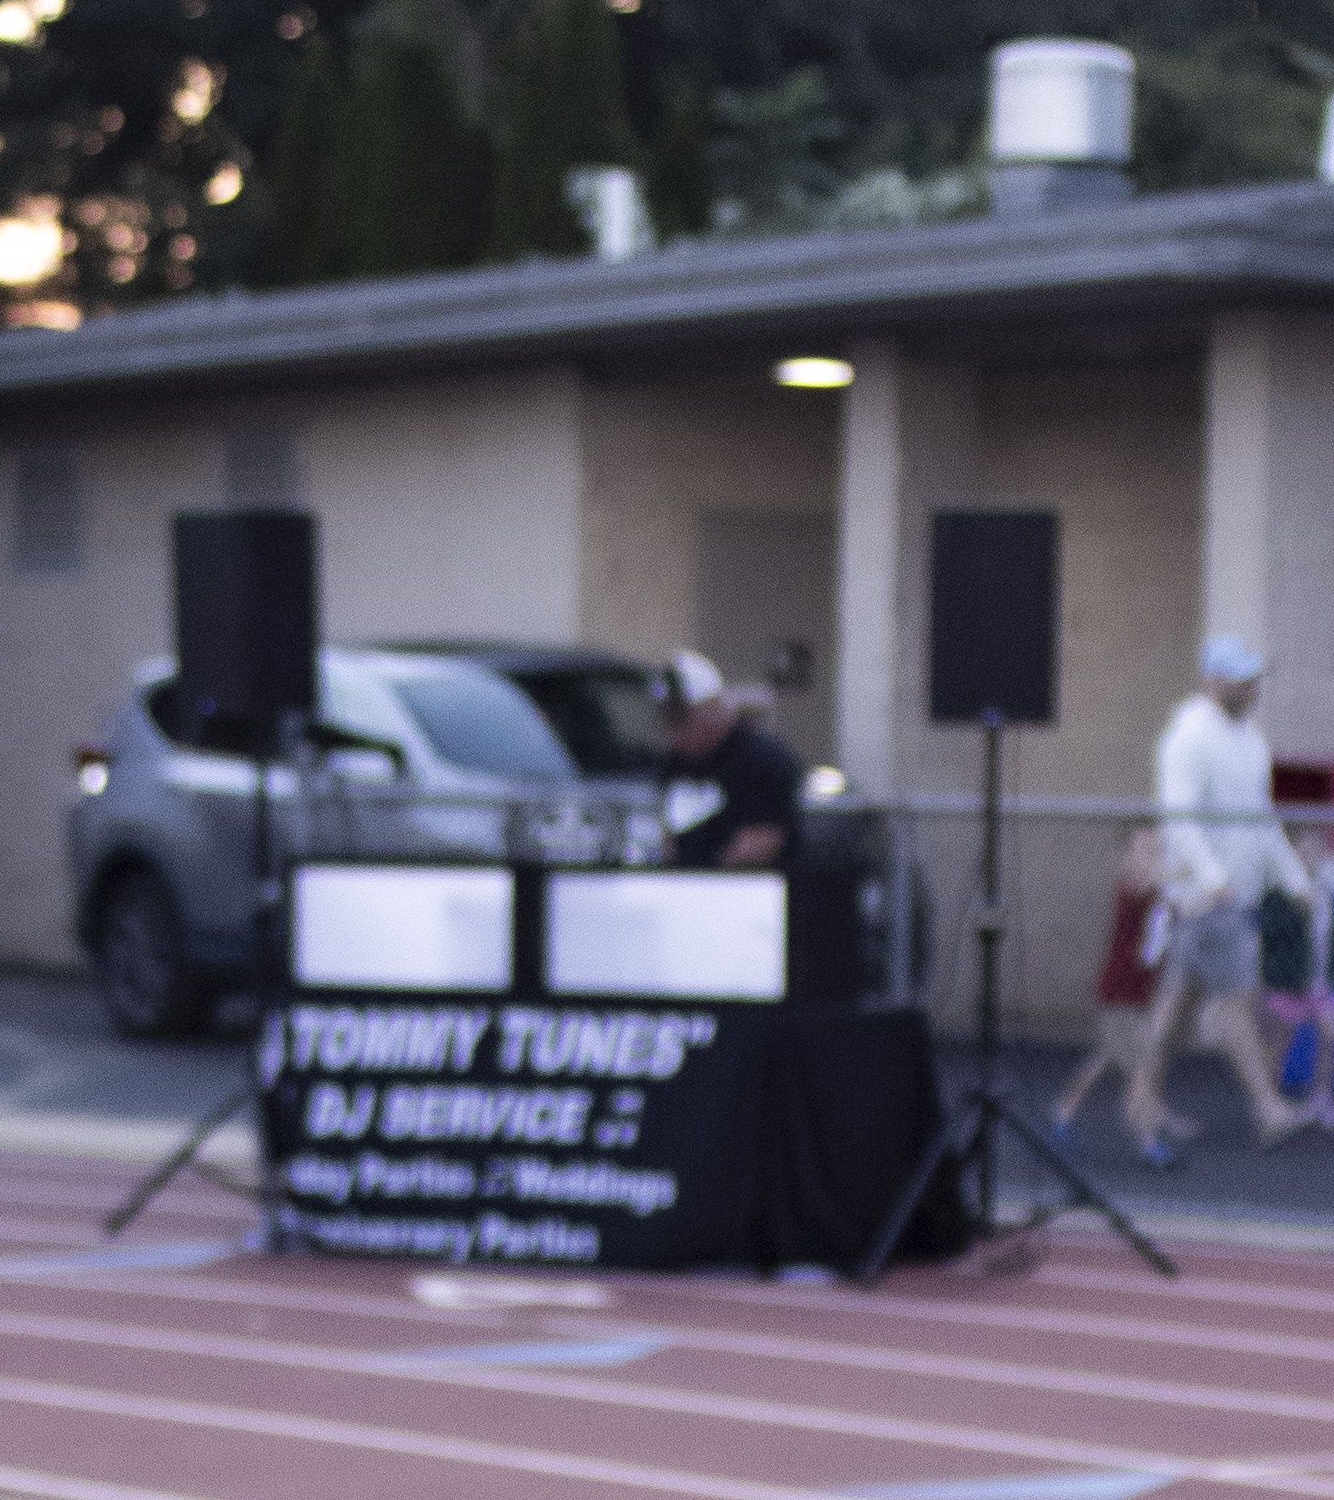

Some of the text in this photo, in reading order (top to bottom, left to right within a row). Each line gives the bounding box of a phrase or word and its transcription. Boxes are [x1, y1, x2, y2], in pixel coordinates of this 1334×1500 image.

[291, 1007, 491, 1071] TOMMY
[304, 1084, 594, 1144] DJ SERVICE
